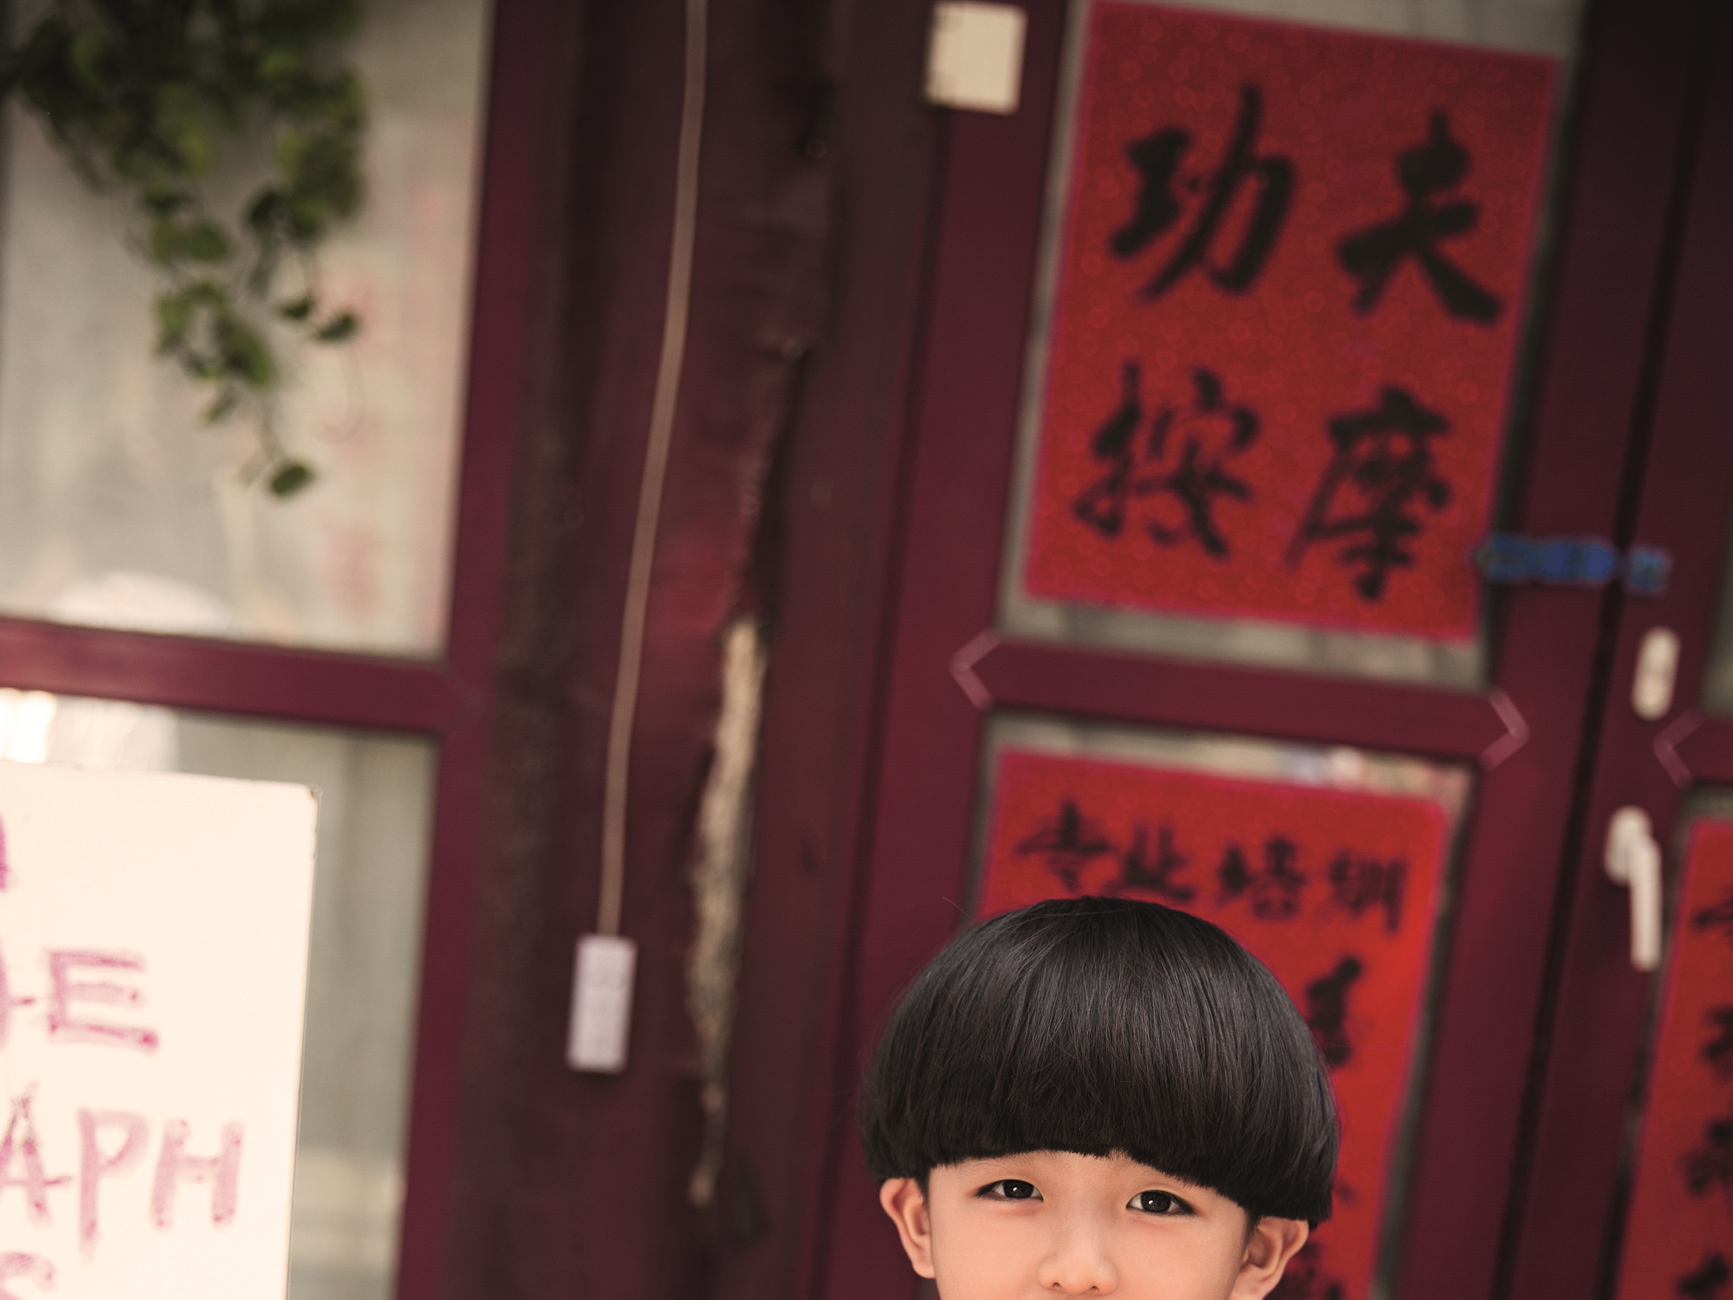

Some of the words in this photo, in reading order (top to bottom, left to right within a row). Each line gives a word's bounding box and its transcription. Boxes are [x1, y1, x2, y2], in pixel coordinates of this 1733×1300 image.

[1108, 84, 1501, 328] 功夫
[1072, 360, 1453, 601] 按摩
[1012, 799, 1409, 932] 专业培训
